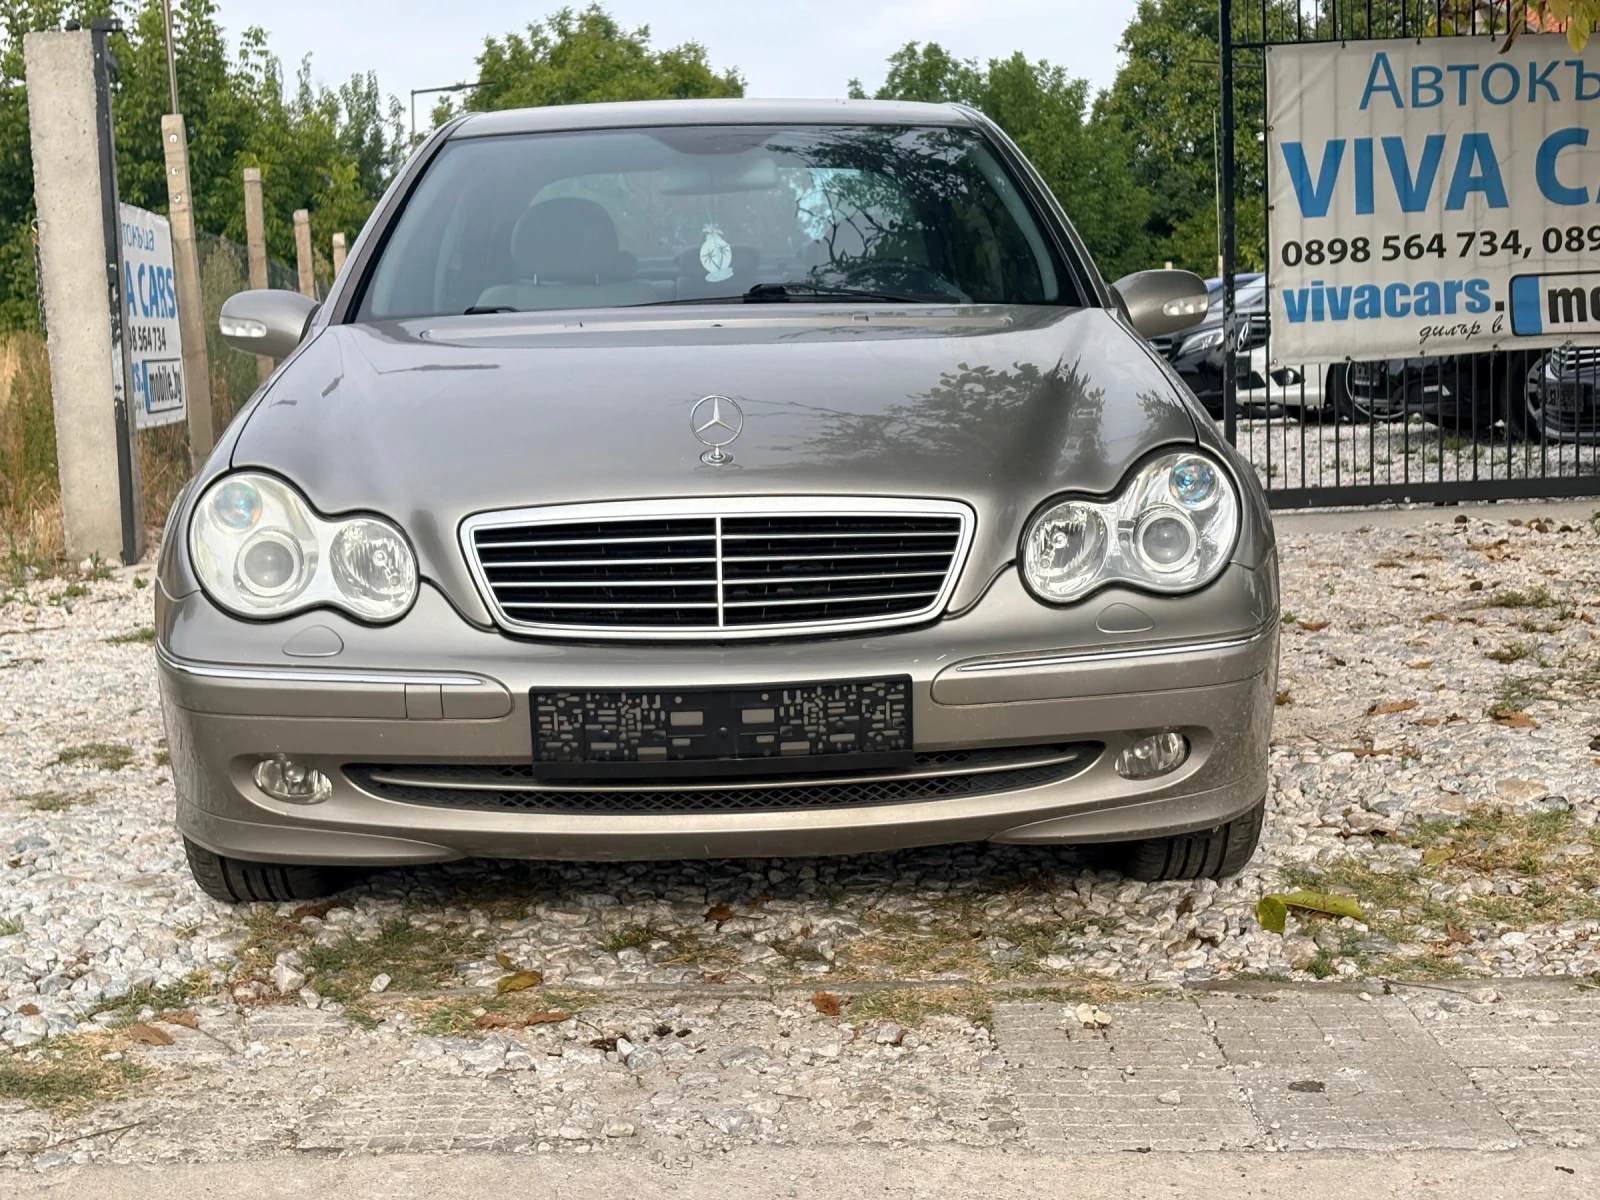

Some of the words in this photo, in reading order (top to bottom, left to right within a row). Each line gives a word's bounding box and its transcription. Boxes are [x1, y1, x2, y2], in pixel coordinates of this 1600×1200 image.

[1280, 132, 1509, 218] VIVA
[1535, 127, 1600, 206] C
[1281, 237, 1371, 267] 0898
[1381, 233, 1446, 261] 564
[1457, 229, 1532, 258] 734,
[138, 263, 176, 319] CARS
[1282, 278, 1505, 324] vivacars.
[138, 325, 152, 352] 564
[152, 326, 167, 352] 734
[149, 364, 182, 403] mobile.bg
